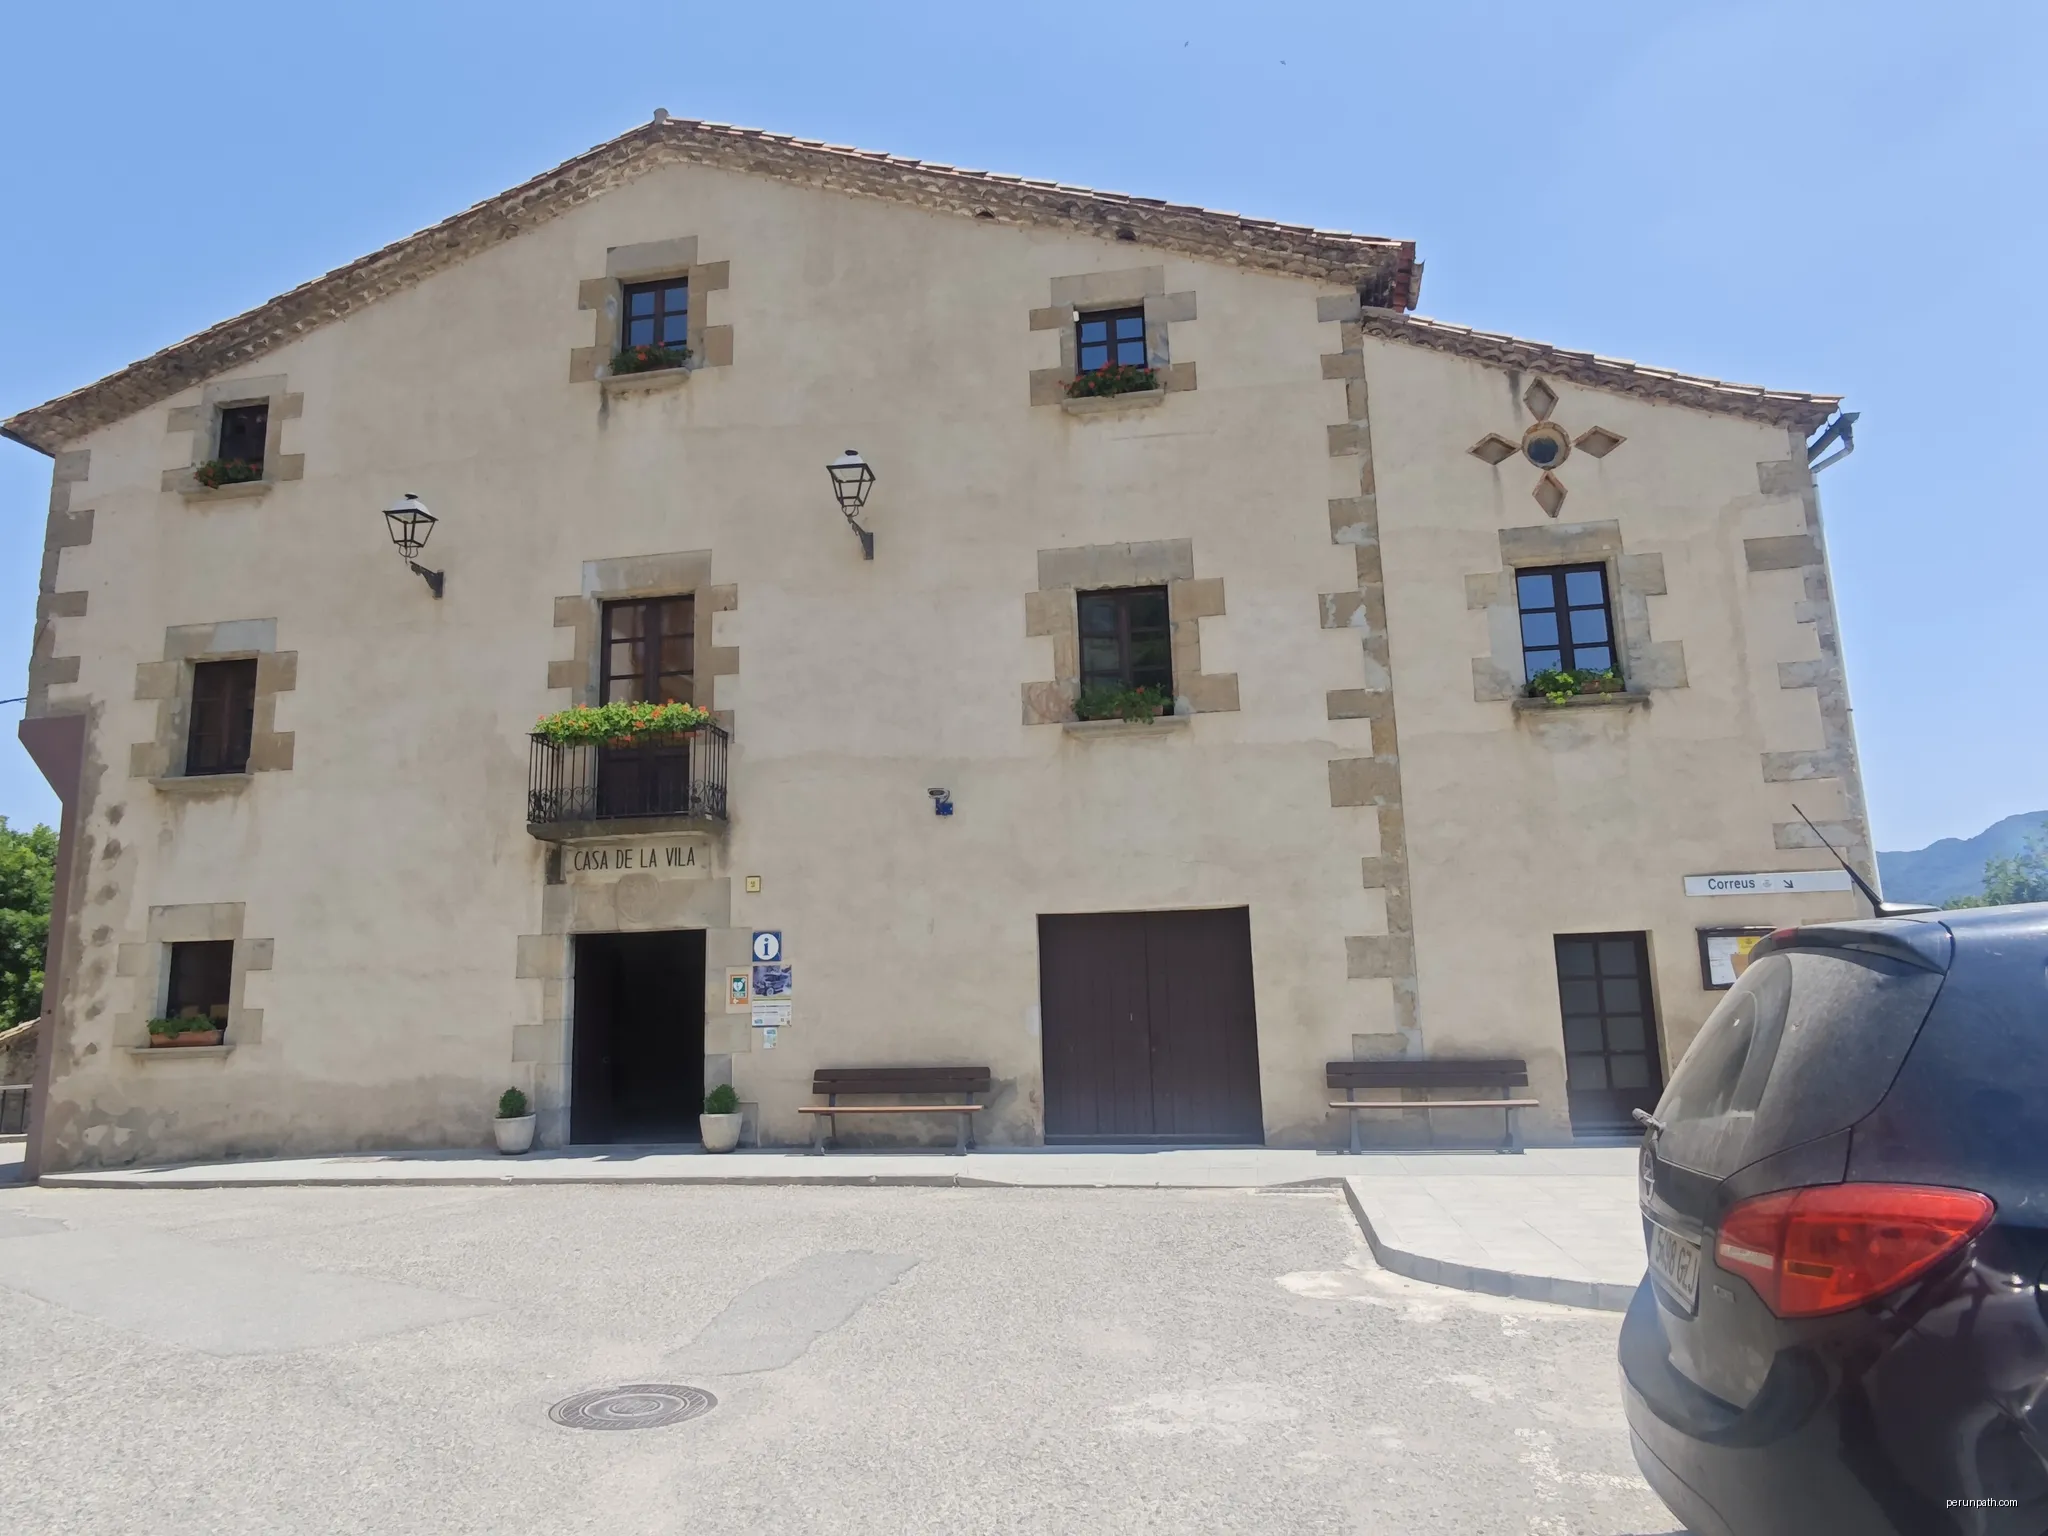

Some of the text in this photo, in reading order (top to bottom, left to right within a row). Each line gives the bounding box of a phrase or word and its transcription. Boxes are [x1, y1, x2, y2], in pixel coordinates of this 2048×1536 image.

[574, 846, 695, 871] CASA DE LA VILA
[1708, 878, 1755, 890] Correus
[1677, 1246, 1698, 1295] GZJ
